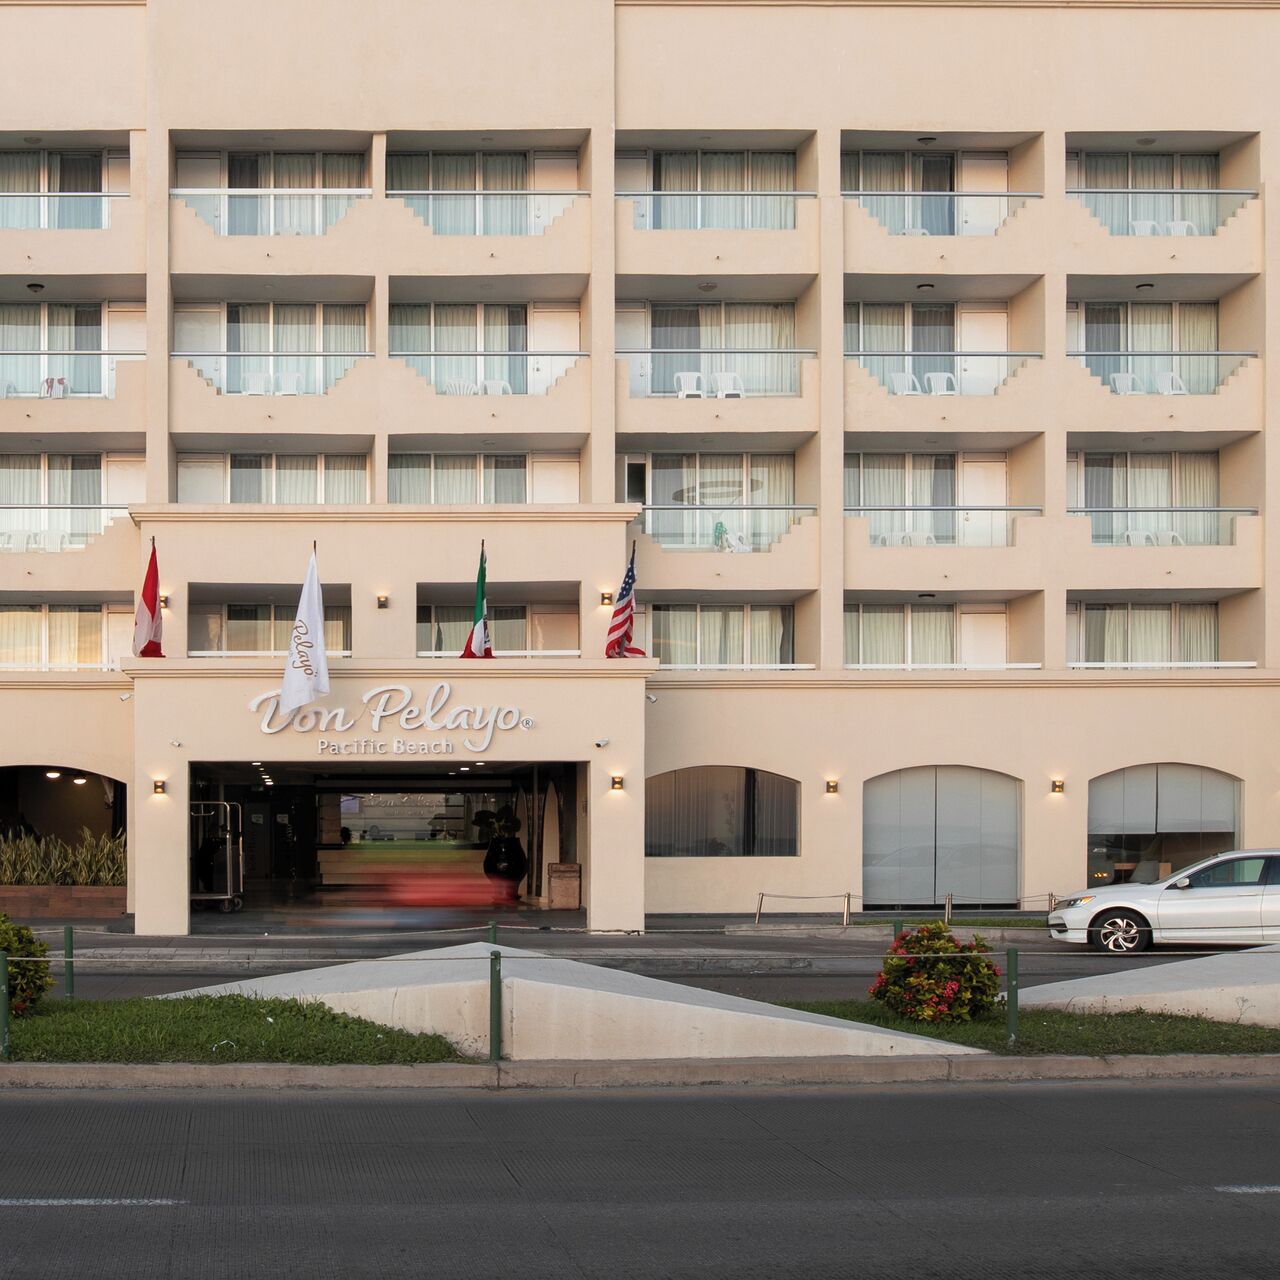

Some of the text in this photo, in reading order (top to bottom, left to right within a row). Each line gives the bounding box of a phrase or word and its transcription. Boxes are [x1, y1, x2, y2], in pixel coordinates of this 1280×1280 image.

[292, 619, 315, 676] Pelayo
[361, 680, 522, 754] Pelayo
[317, 738, 454, 755] Pacific Beach
